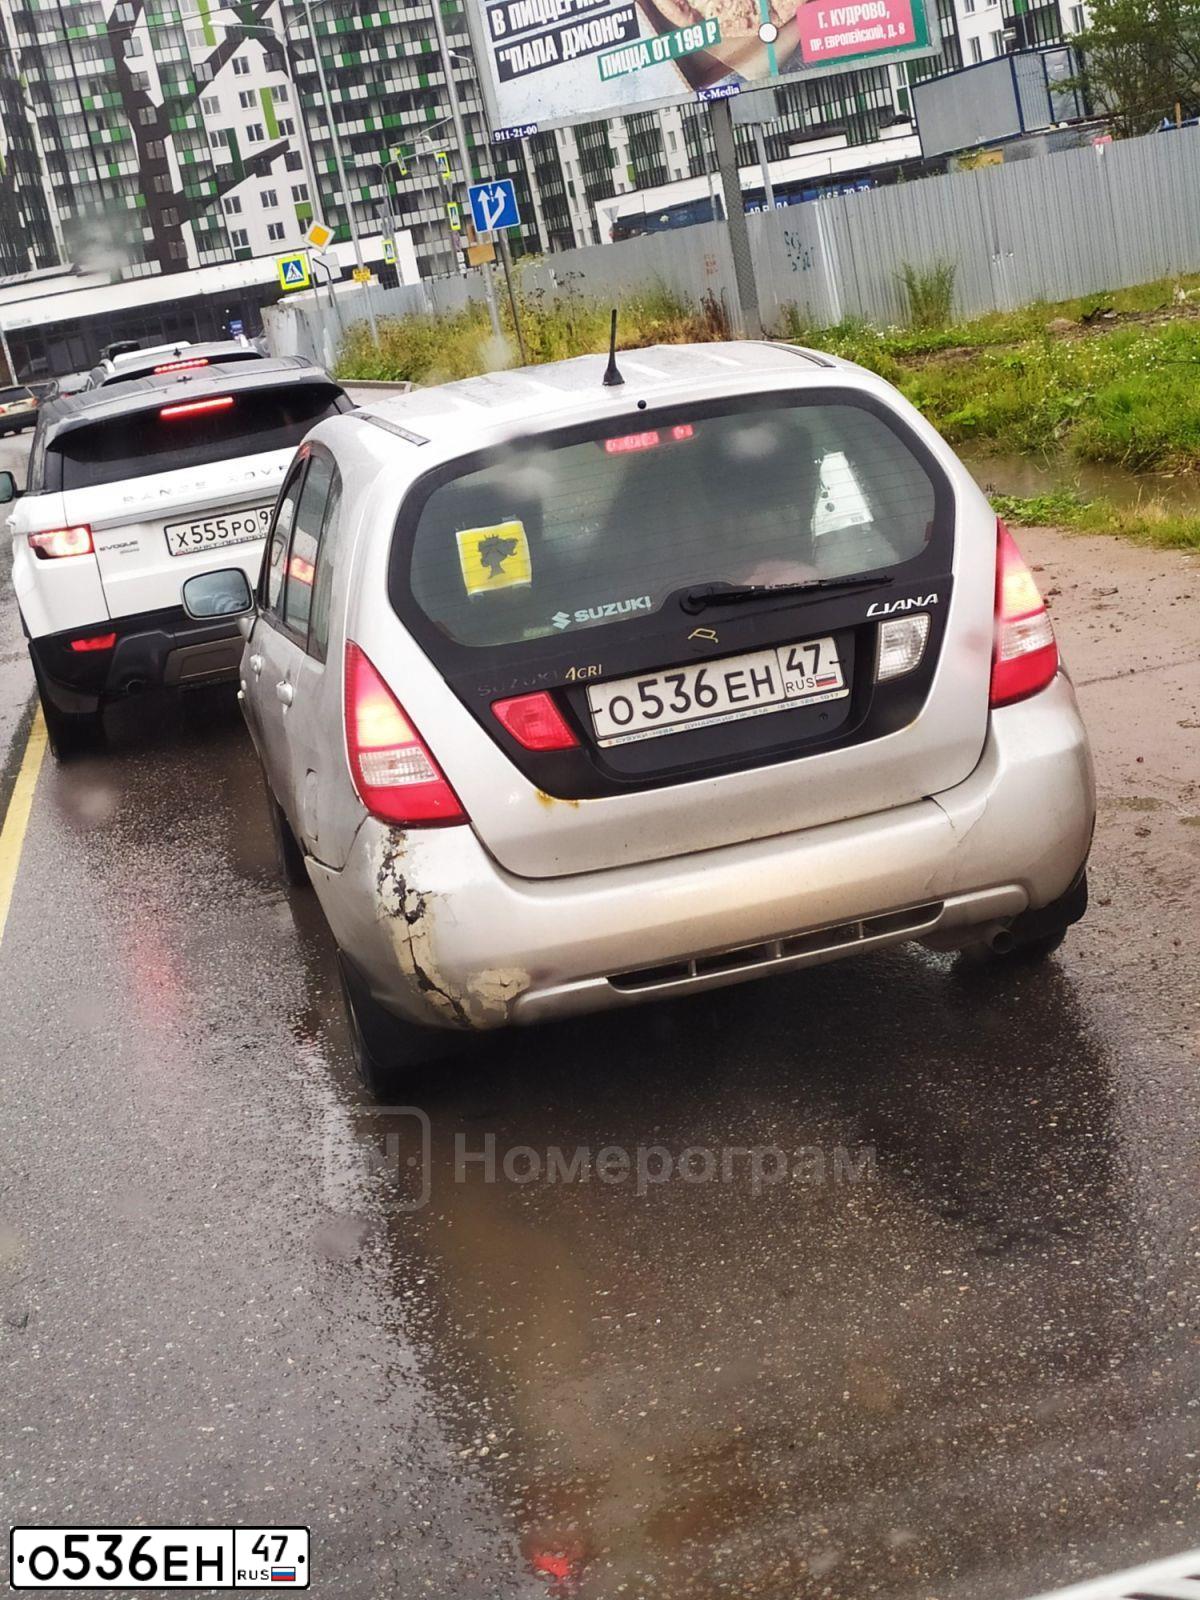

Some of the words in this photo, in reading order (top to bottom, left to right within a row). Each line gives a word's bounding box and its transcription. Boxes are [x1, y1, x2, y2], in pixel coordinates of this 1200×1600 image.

[491, 9, 506, 36] В
[507, 0, 607, 30] ПИЦЦЕР
[829, 1, 890, 27] КУДРОВО,
[499, 35, 559, 73] "ПАПА
[559, 9, 634, 61] ДЖОНС"
[898, 22, 906, 35] 8
[600, 43, 651, 78] ПИЦЦА
[651, 35, 671, 61] ОТ
[674, 25, 705, 54] 199
[698, 85, 740, 101] K-Media
[494, 124, 538, 141] 911-21-00
[227, 464, 289, 484] ROVE
[176, 518, 257, 549] Х555РО
[259, 508, 276, 526] 9
[574, 595, 652, 623] SUZUKI
[866, 593, 939, 617] LIANA
[608, 664, 776, 726] О536ЕН
[786, 643, 821, 677] 47
[785, 677, 815, 693] RUS
